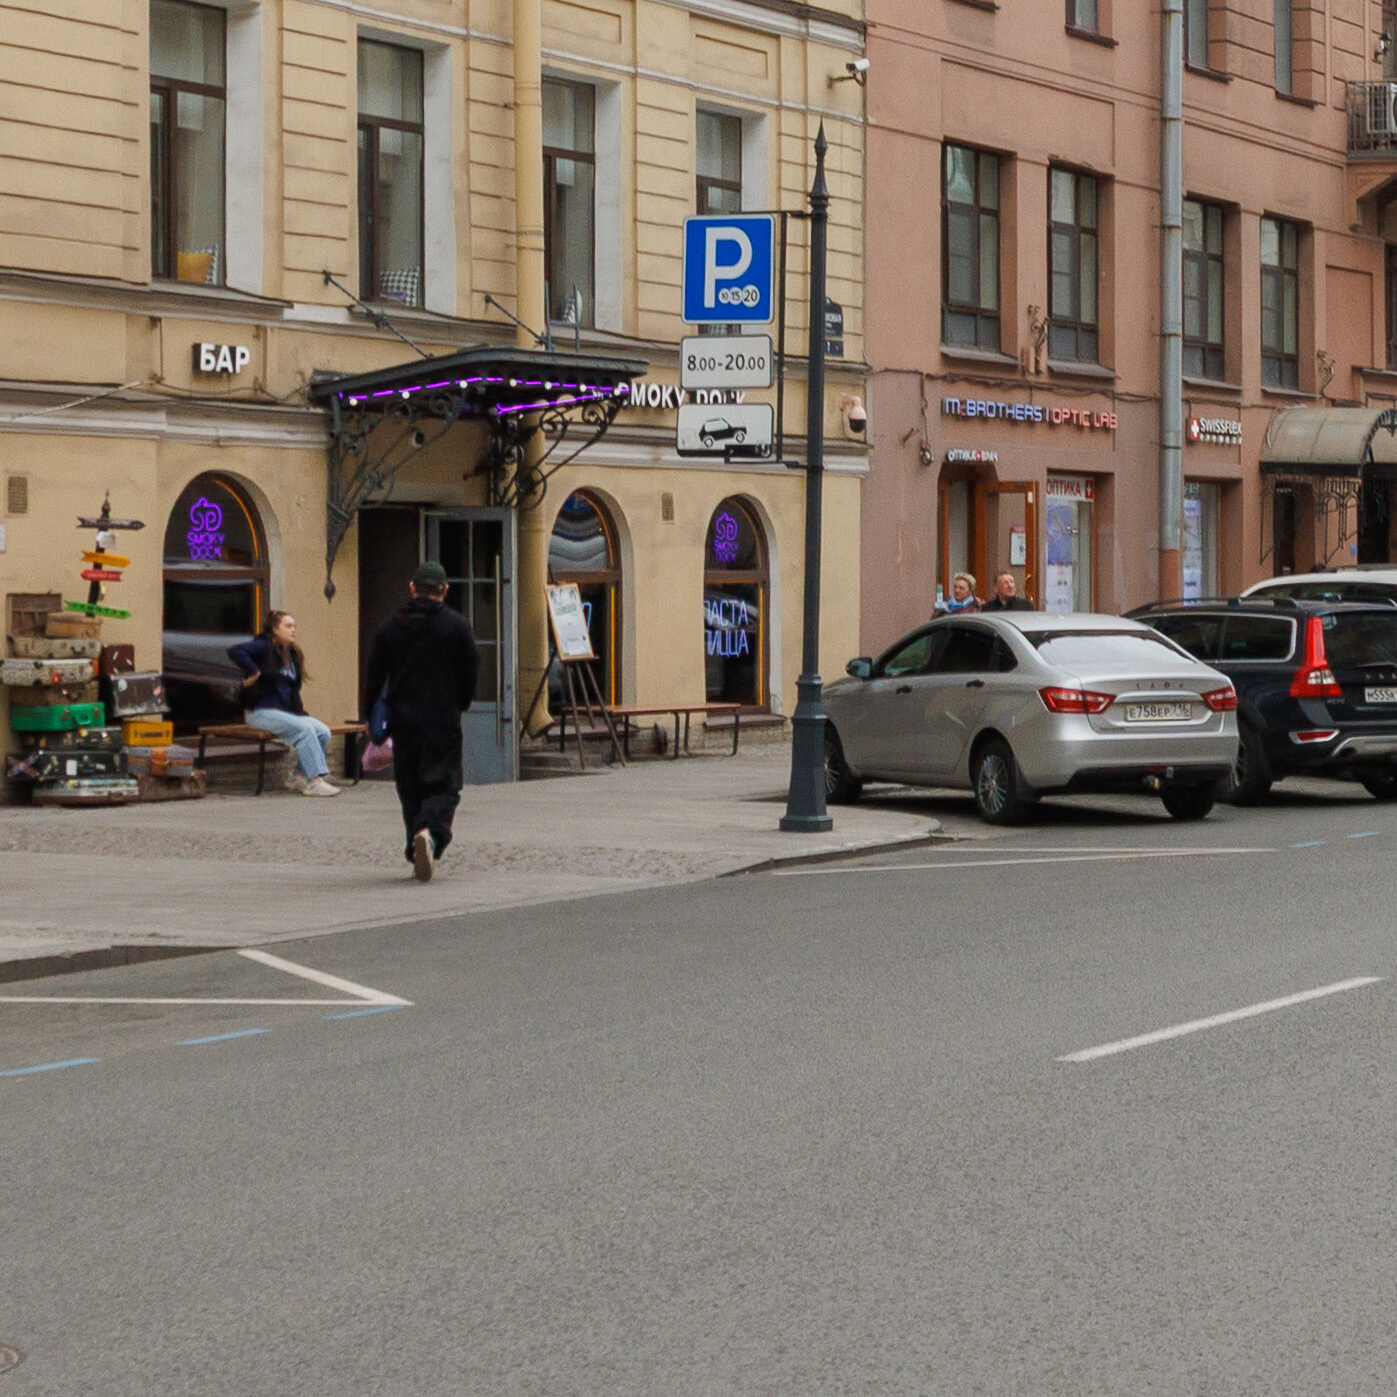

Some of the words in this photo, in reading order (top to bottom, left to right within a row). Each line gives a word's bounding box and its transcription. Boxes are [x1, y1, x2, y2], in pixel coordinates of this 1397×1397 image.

[704, 227, 753, 308] P
[731, 289, 741, 300] 15
[744, 288, 758, 302] 20
[200, 343, 250, 373] БАР
[687, 355, 765, 371] 8.00-20.00
[1052, 408, 1091, 427] OPTIC
[1094, 412, 1118, 429] LAB
[1046, 479, 1082, 496] ОПТИКА
